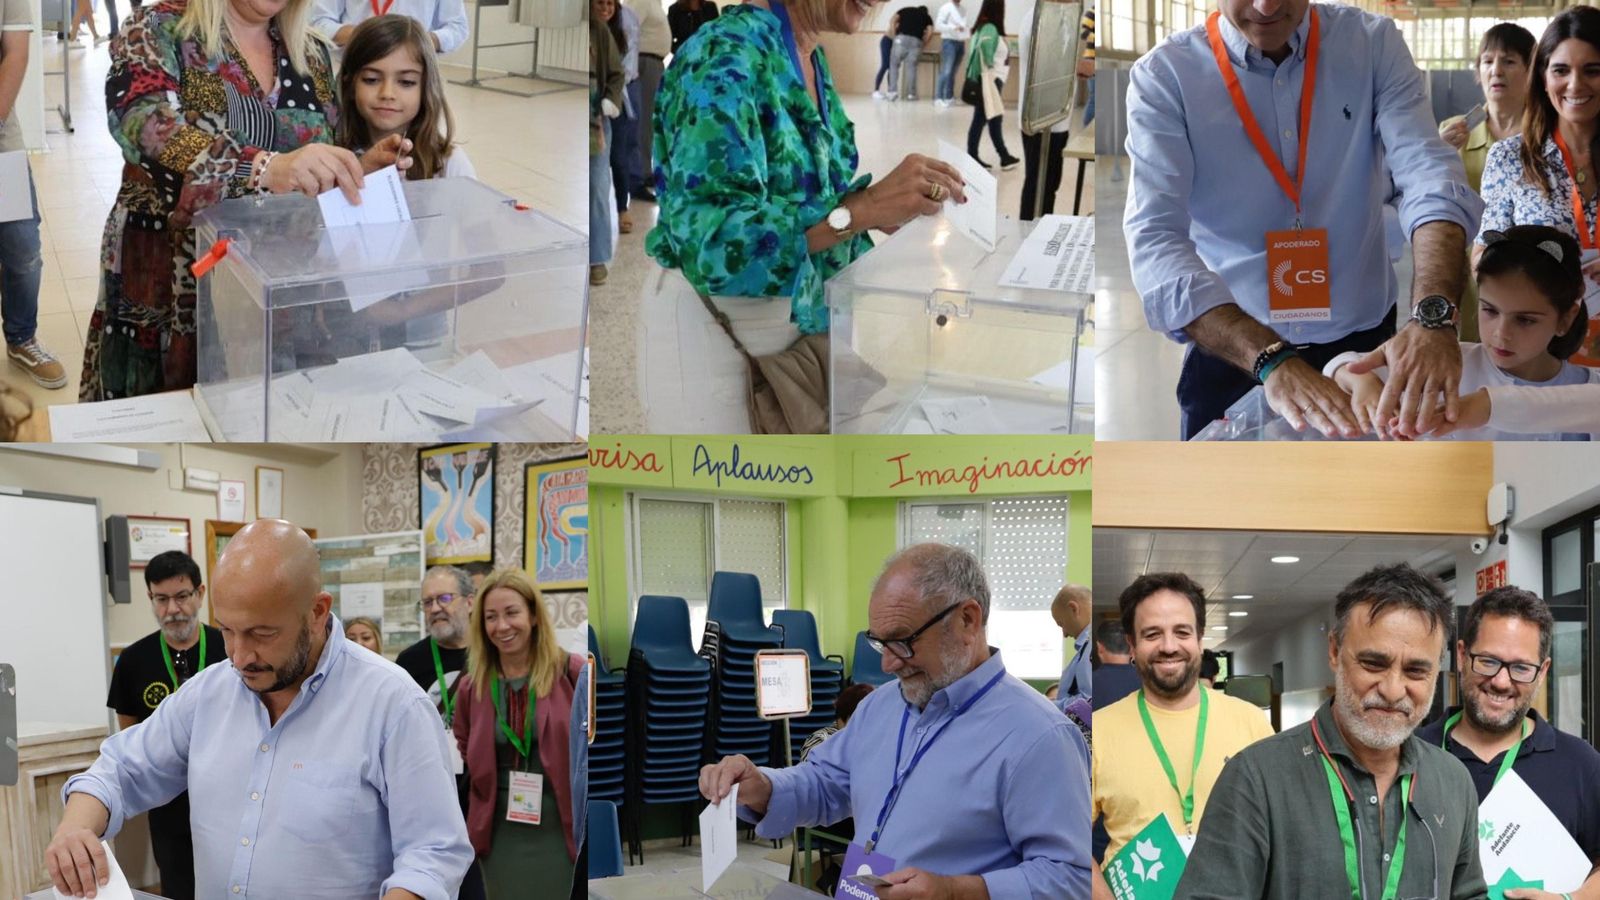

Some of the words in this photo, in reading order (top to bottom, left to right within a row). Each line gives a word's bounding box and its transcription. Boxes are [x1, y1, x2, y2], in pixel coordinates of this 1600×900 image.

[1273, 240, 1320, 248] APODERADO
[1295, 269, 1326, 284] CS
[693, 443, 814, 488] Aplausos
[886, 450, 1093, 493] Imaginación
[761, 677, 782, 686] MESA
[1490, 822, 1513, 852] Adelante
